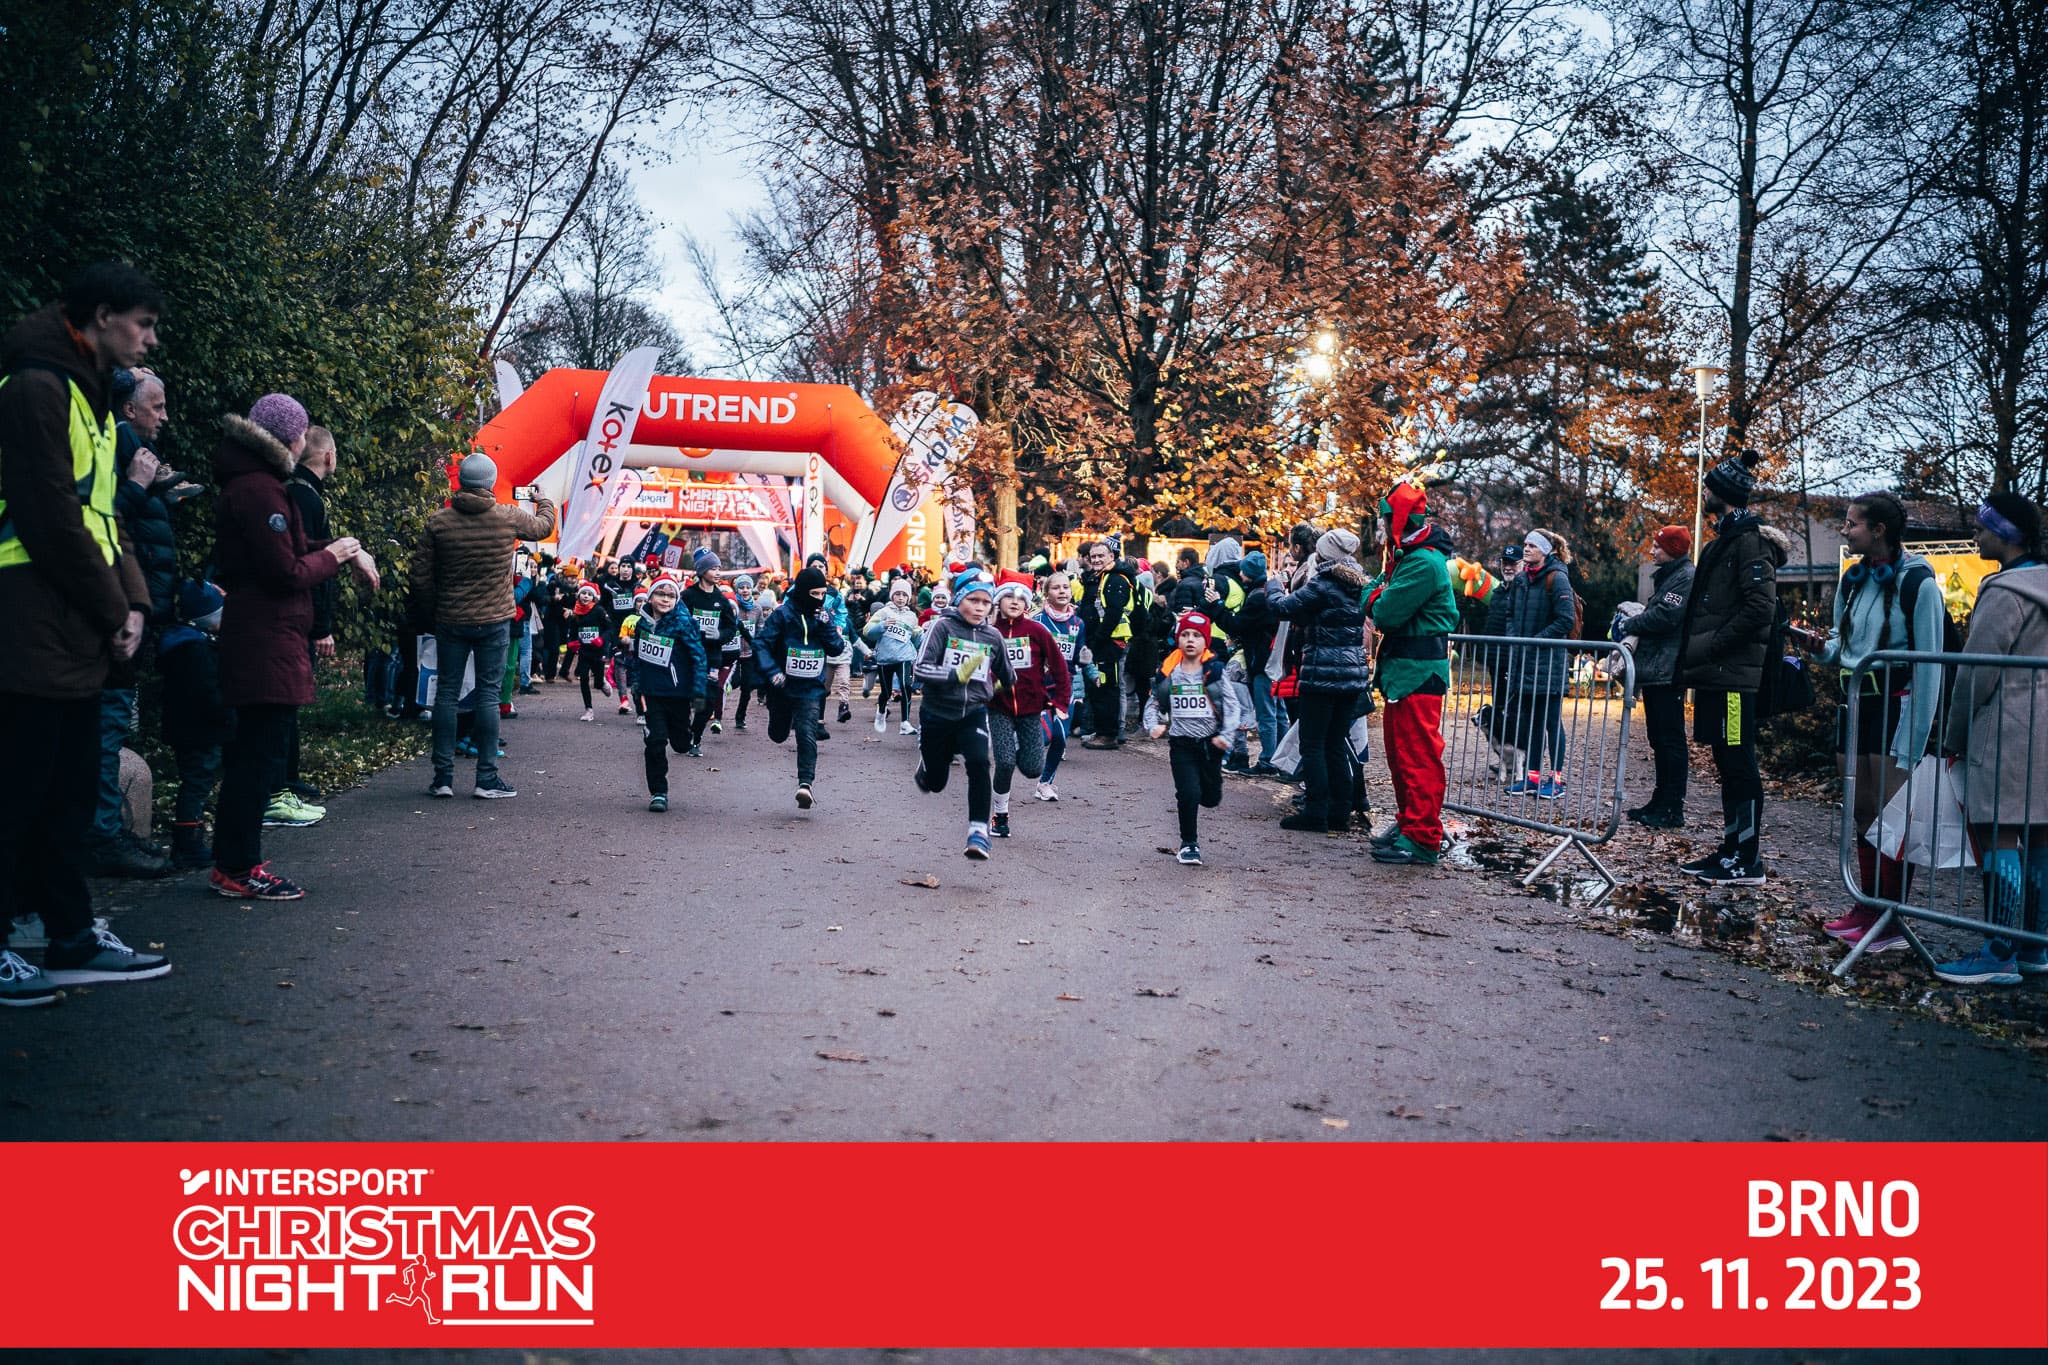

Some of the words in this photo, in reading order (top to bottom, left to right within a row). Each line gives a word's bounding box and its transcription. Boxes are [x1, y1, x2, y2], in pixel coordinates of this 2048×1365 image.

[642, 391, 797, 424] UTREND
[639, 495, 667, 503] SPORT
[641, 642, 664, 658] 3001
[1009, 648, 1024, 661] 30
[791, 659, 819, 671] 3052
[1174, 696, 1207, 709] 3008
